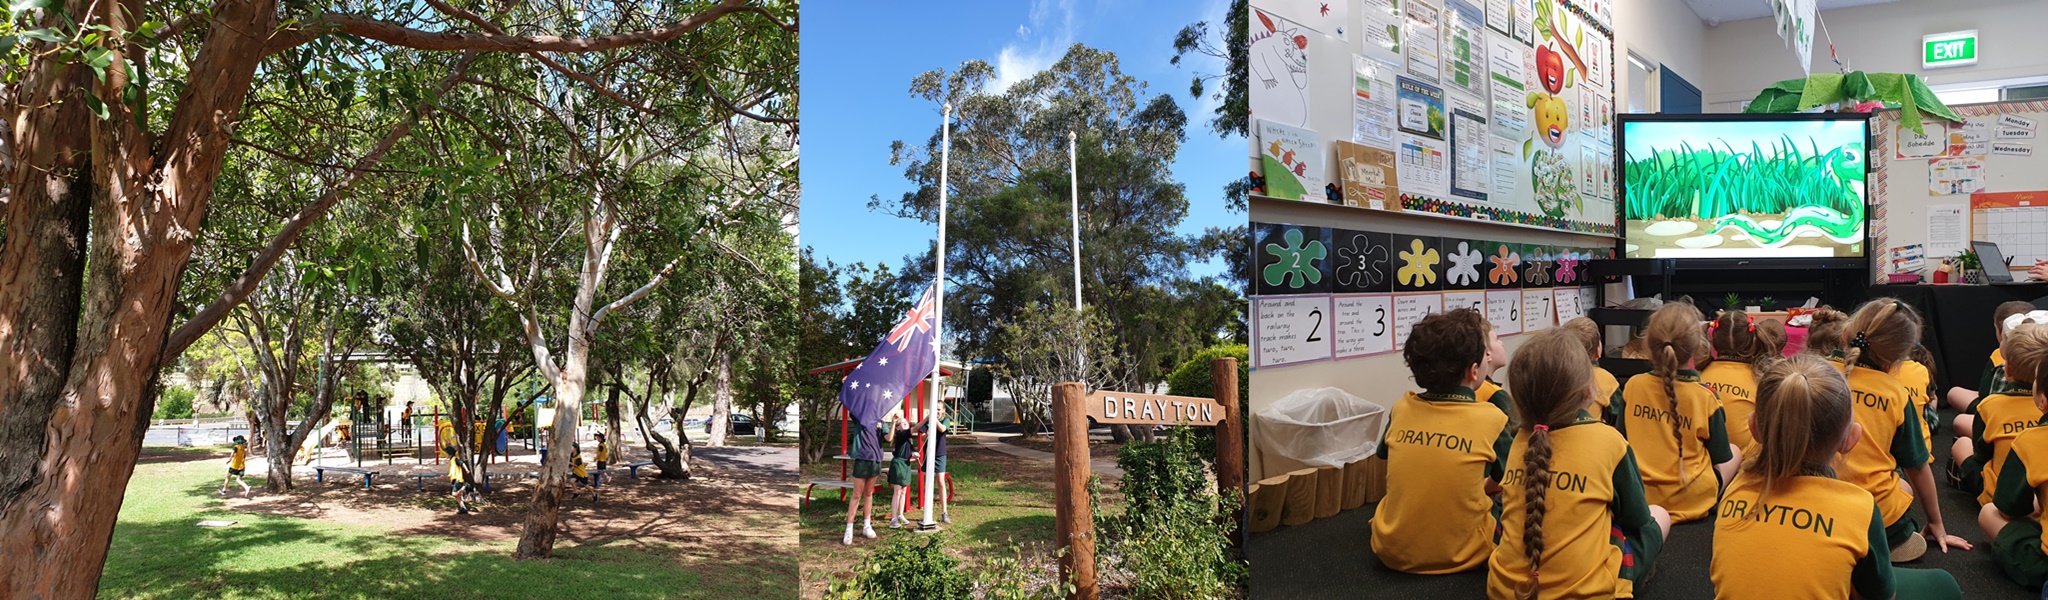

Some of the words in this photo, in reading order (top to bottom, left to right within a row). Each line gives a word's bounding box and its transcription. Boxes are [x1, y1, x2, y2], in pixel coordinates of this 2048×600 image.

[1933, 41, 1966, 60] EXIT
[2004, 116, 2030, 128] Monday
[1291, 251, 1300, 268] 2
[1358, 254, 1366, 270] 3
[1415, 257, 1423, 270] 4
[1503, 259, 1507, 272] 6
[1536, 262, 1541, 273] 7
[1564, 261, 1569, 272] 8
[1510, 301, 1518, 321] 6
[1542, 297, 1549, 318] 7
[1573, 296, 1581, 315] 8
[1260, 312, 1274, 320] back
[1373, 307, 1386, 336] 3
[1266, 322, 1290, 332] railway
[1306, 309, 1323, 342] 2
[1104, 396, 1212, 422] DRAYTON
[1396, 429, 1473, 453] DRAYTON
[1503, 468, 1587, 493] DRTON
